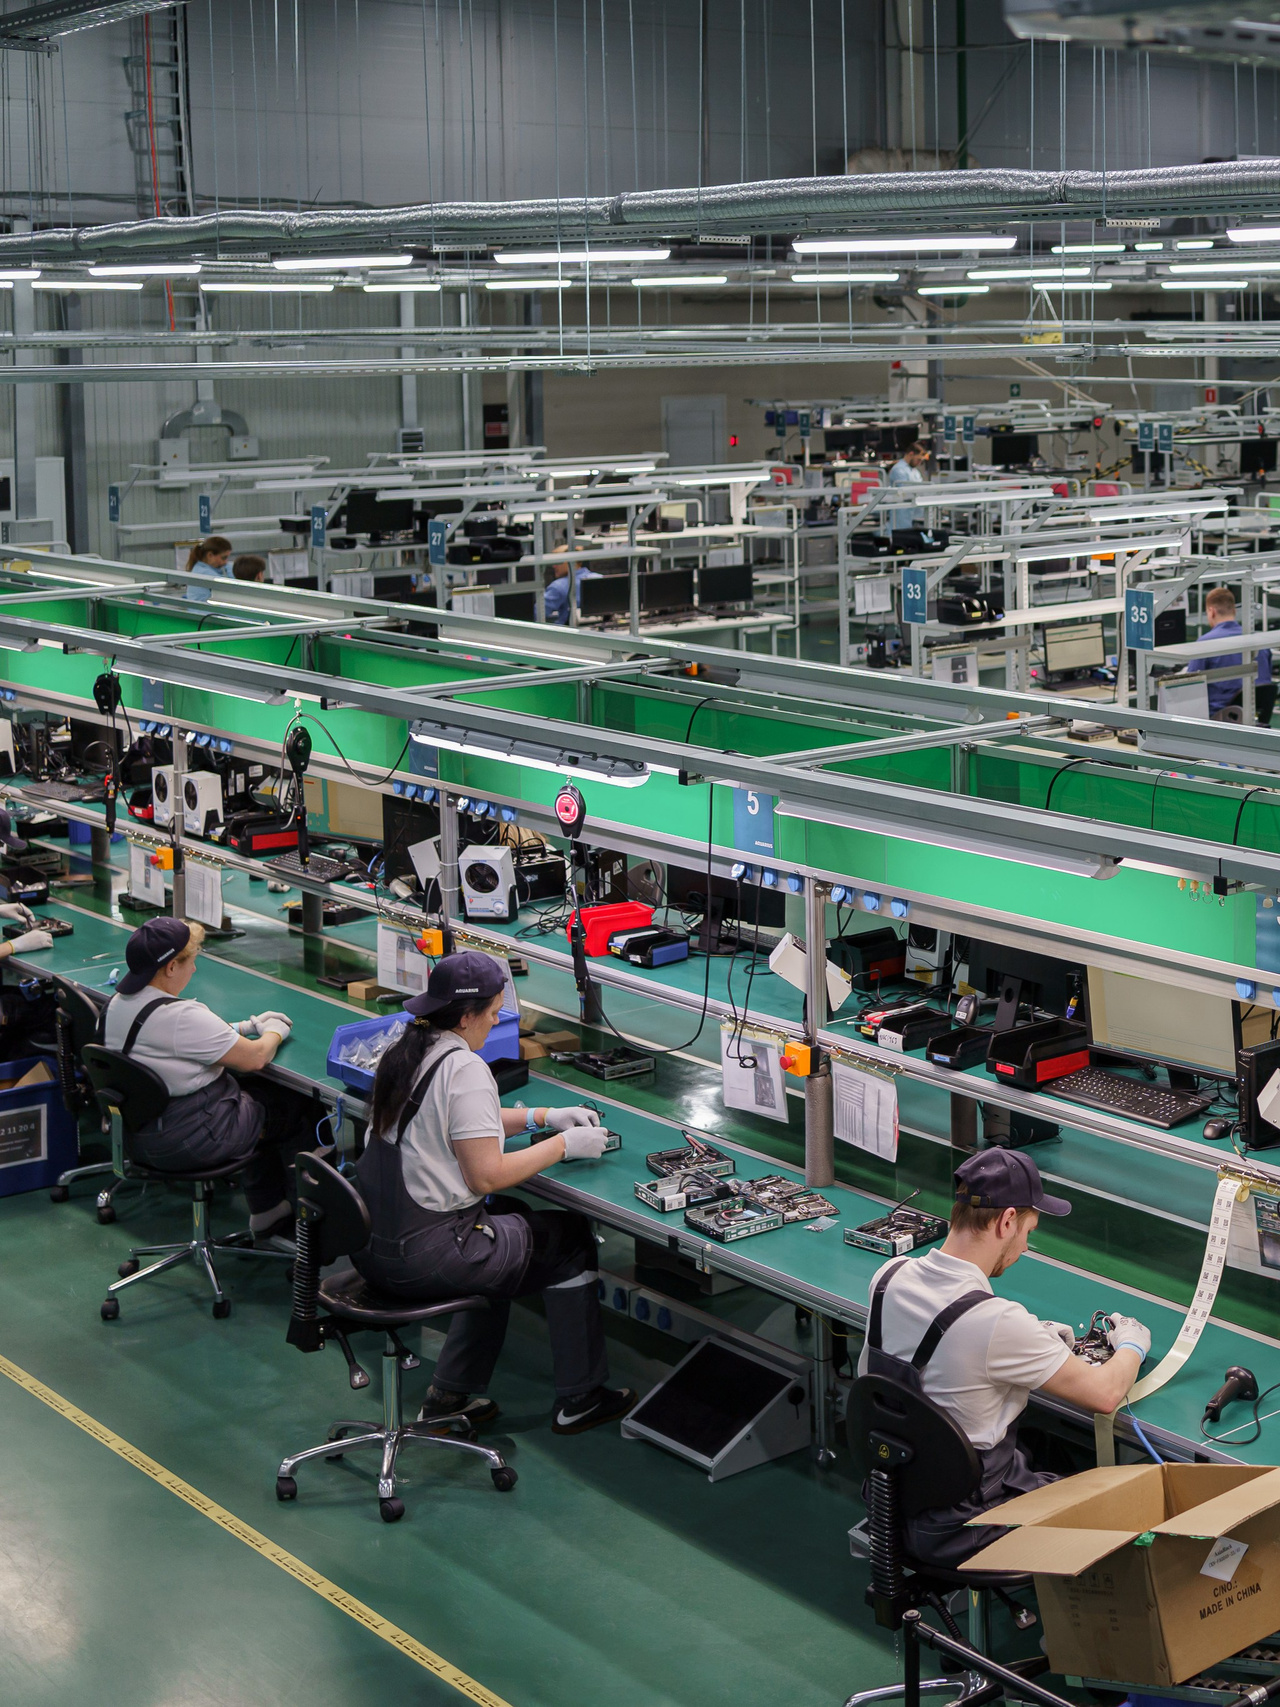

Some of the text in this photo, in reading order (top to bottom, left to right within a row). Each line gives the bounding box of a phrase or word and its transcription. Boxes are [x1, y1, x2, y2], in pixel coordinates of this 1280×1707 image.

[313, 516, 323, 530] 25
[431, 532, 442, 546] 27
[907, 583, 921, 599] 33
[1131, 605, 1148, 624] 35
[747, 790, 760, 815] 5
[1212, 1580, 1238, 1598] C/NO.:
[1199, 1582, 1262, 1620] MADE IN CHINA
